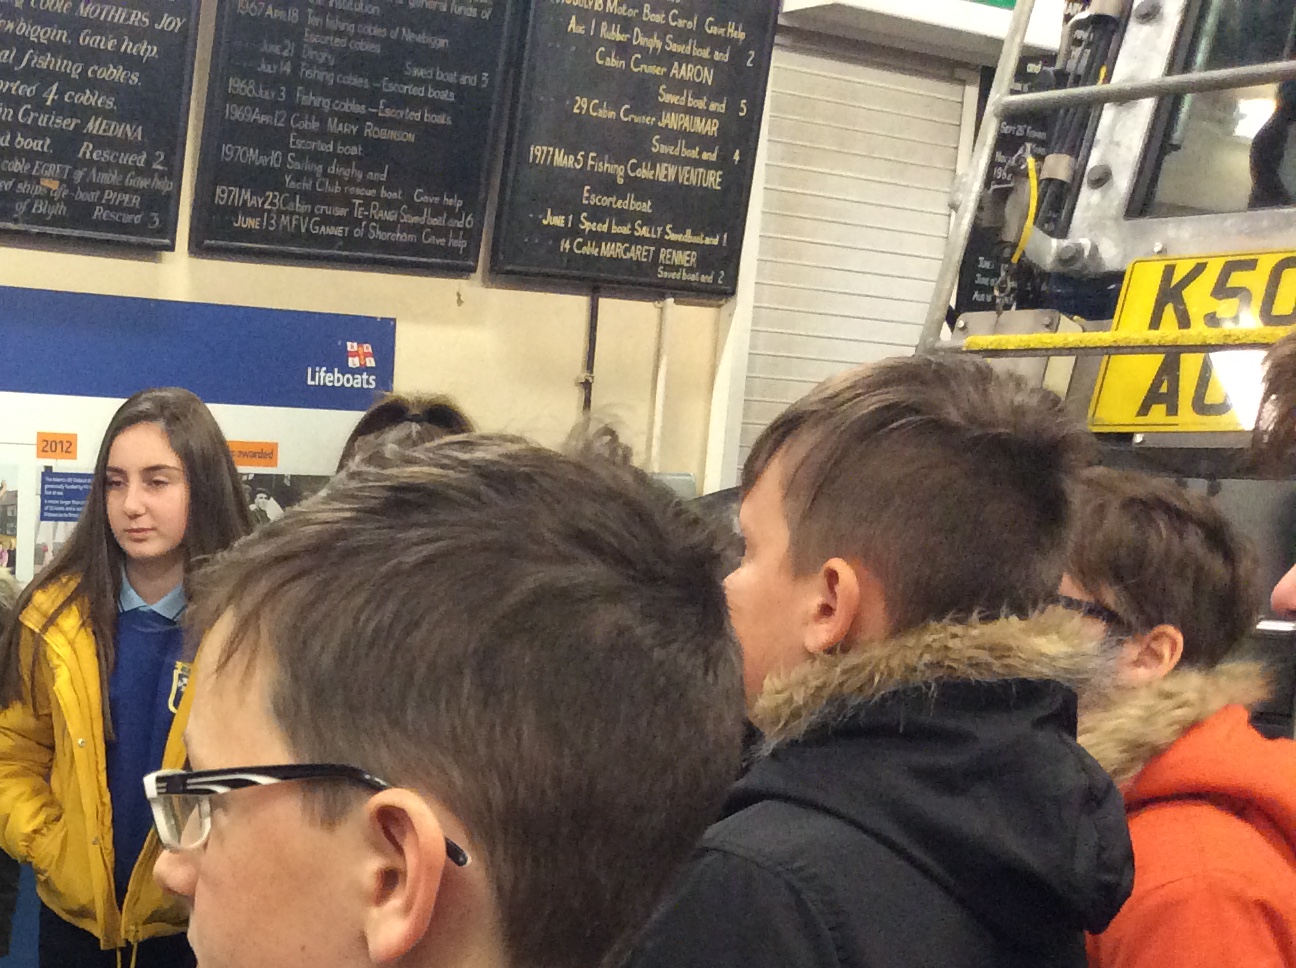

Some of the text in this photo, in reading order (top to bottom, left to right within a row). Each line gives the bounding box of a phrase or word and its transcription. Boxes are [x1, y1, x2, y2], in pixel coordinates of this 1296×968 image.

[75, 0, 187, 33] MOTHERS JOY
[605, 0, 639, 17] Motor
[642, 3, 666, 24] Boat
[704, 17, 726, 36] Gave
[726, 20, 746, 45] Help
[79, 28, 118, 52] Gave
[600, 21, 755, 67] Rubber Dinghy Saved boat and 2
[14, 48, 85, 80] fishing
[595, 47, 714, 86] Cabin Cruiser AARON
[228, 76, 255, 97] 1968
[296, 86, 331, 113] Fishing
[377, 99, 421, 121] Escorted
[572, 96, 588, 115] 29
[589, 99, 616, 119] Cabin
[620, 104, 656, 125] Cruiser
[657, 84, 747, 117] Saved boat and 5
[18, 103, 81, 132] Cruiser
[83, 114, 143, 141] MEDINA
[225, 103, 415, 143] 1969 Coble MARY ROBINSON
[78, 141, 146, 167] Rescued
[289, 132, 333, 153] Escorted
[651, 134, 741, 165] Saved boat and 4
[1, 158, 31, 174] coble
[32, 160, 72, 180] EGRET
[221, 143, 388, 182] 1970 Sailing dinghy and
[529, 144, 723, 190] 1977 MAR 5 Fishing Coble NEW VENTURE
[102, 189, 141, 209] PIPER
[215, 184, 239, 206] 1971
[238, 188, 264, 208] MAY
[264, 191, 280, 210] 23
[279, 193, 312, 214] Cabin
[314, 205, 349, 218] cruiser
[465, 213, 474, 229] 6
[284, 174, 313, 191] Yacht
[315, 178, 342, 193] Club
[380, 185, 402, 200] boat
[413, 188, 440, 204] Gave
[442, 192, 463, 213] help
[582, 185, 653, 213] Escorted boat
[15, 199, 143, 225] of Blyth Rescued
[579, 212, 609, 235] Speed
[611, 216, 632, 235] boat
[233, 210, 261, 230] JUNE
[262, 212, 278, 231] 13
[309, 216, 350, 237] GANNET
[353, 221, 367, 238] of
[421, 228, 447, 247] Gave
[447, 230, 468, 254] help
[573, 238, 599, 256] Coble
[600, 241, 655, 263] MARGARET
[658, 247, 697, 268] RENNER
[657, 266, 725, 285] Saved 2
[306, 366, 377, 390] Lifeboats
[41, 439, 73, 454] 2012
[237, 448, 274, 460] awarded
